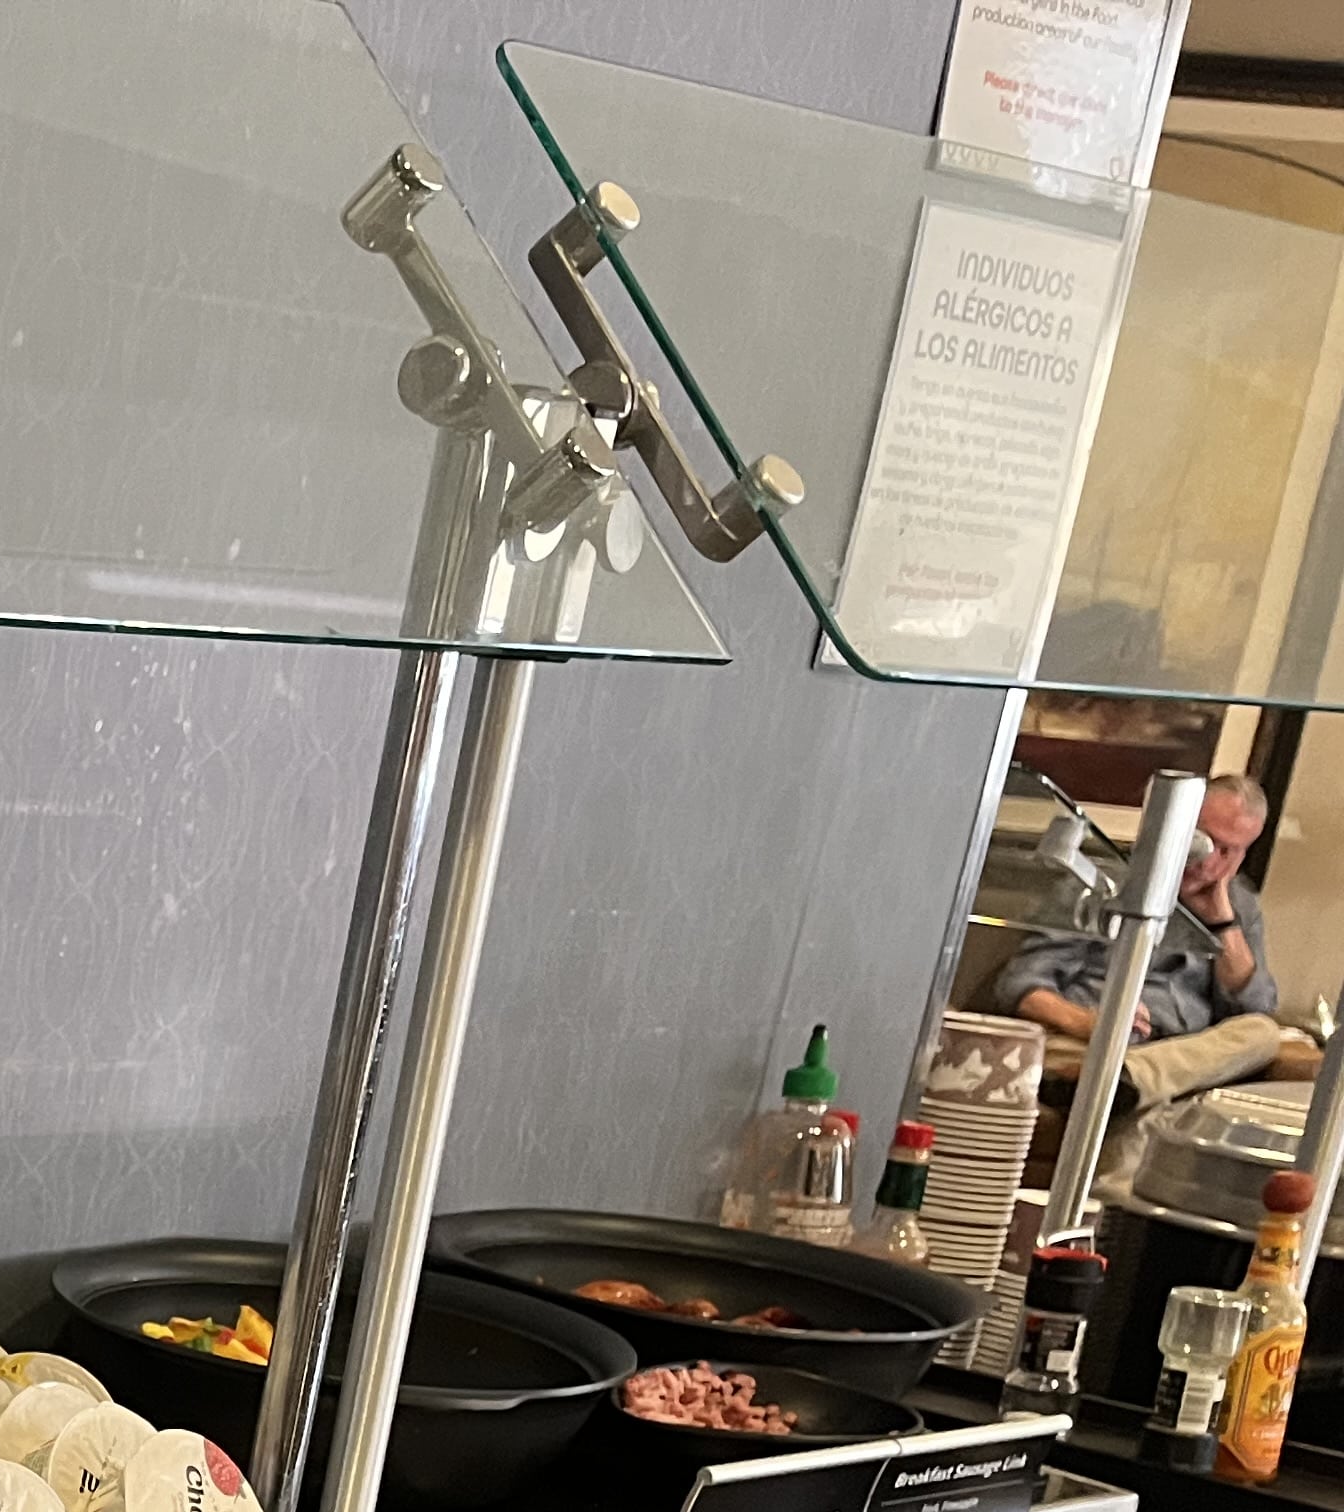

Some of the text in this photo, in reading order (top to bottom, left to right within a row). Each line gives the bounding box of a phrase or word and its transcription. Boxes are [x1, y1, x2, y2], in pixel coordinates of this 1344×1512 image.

[972, 5, 1033, 32] production
[957, 250, 1075, 300] INDIVIDUOS
[933, 288, 1073, 343] ALÉRGICOS A
[914, 330, 1079, 385] LOS ALIMENTOS
